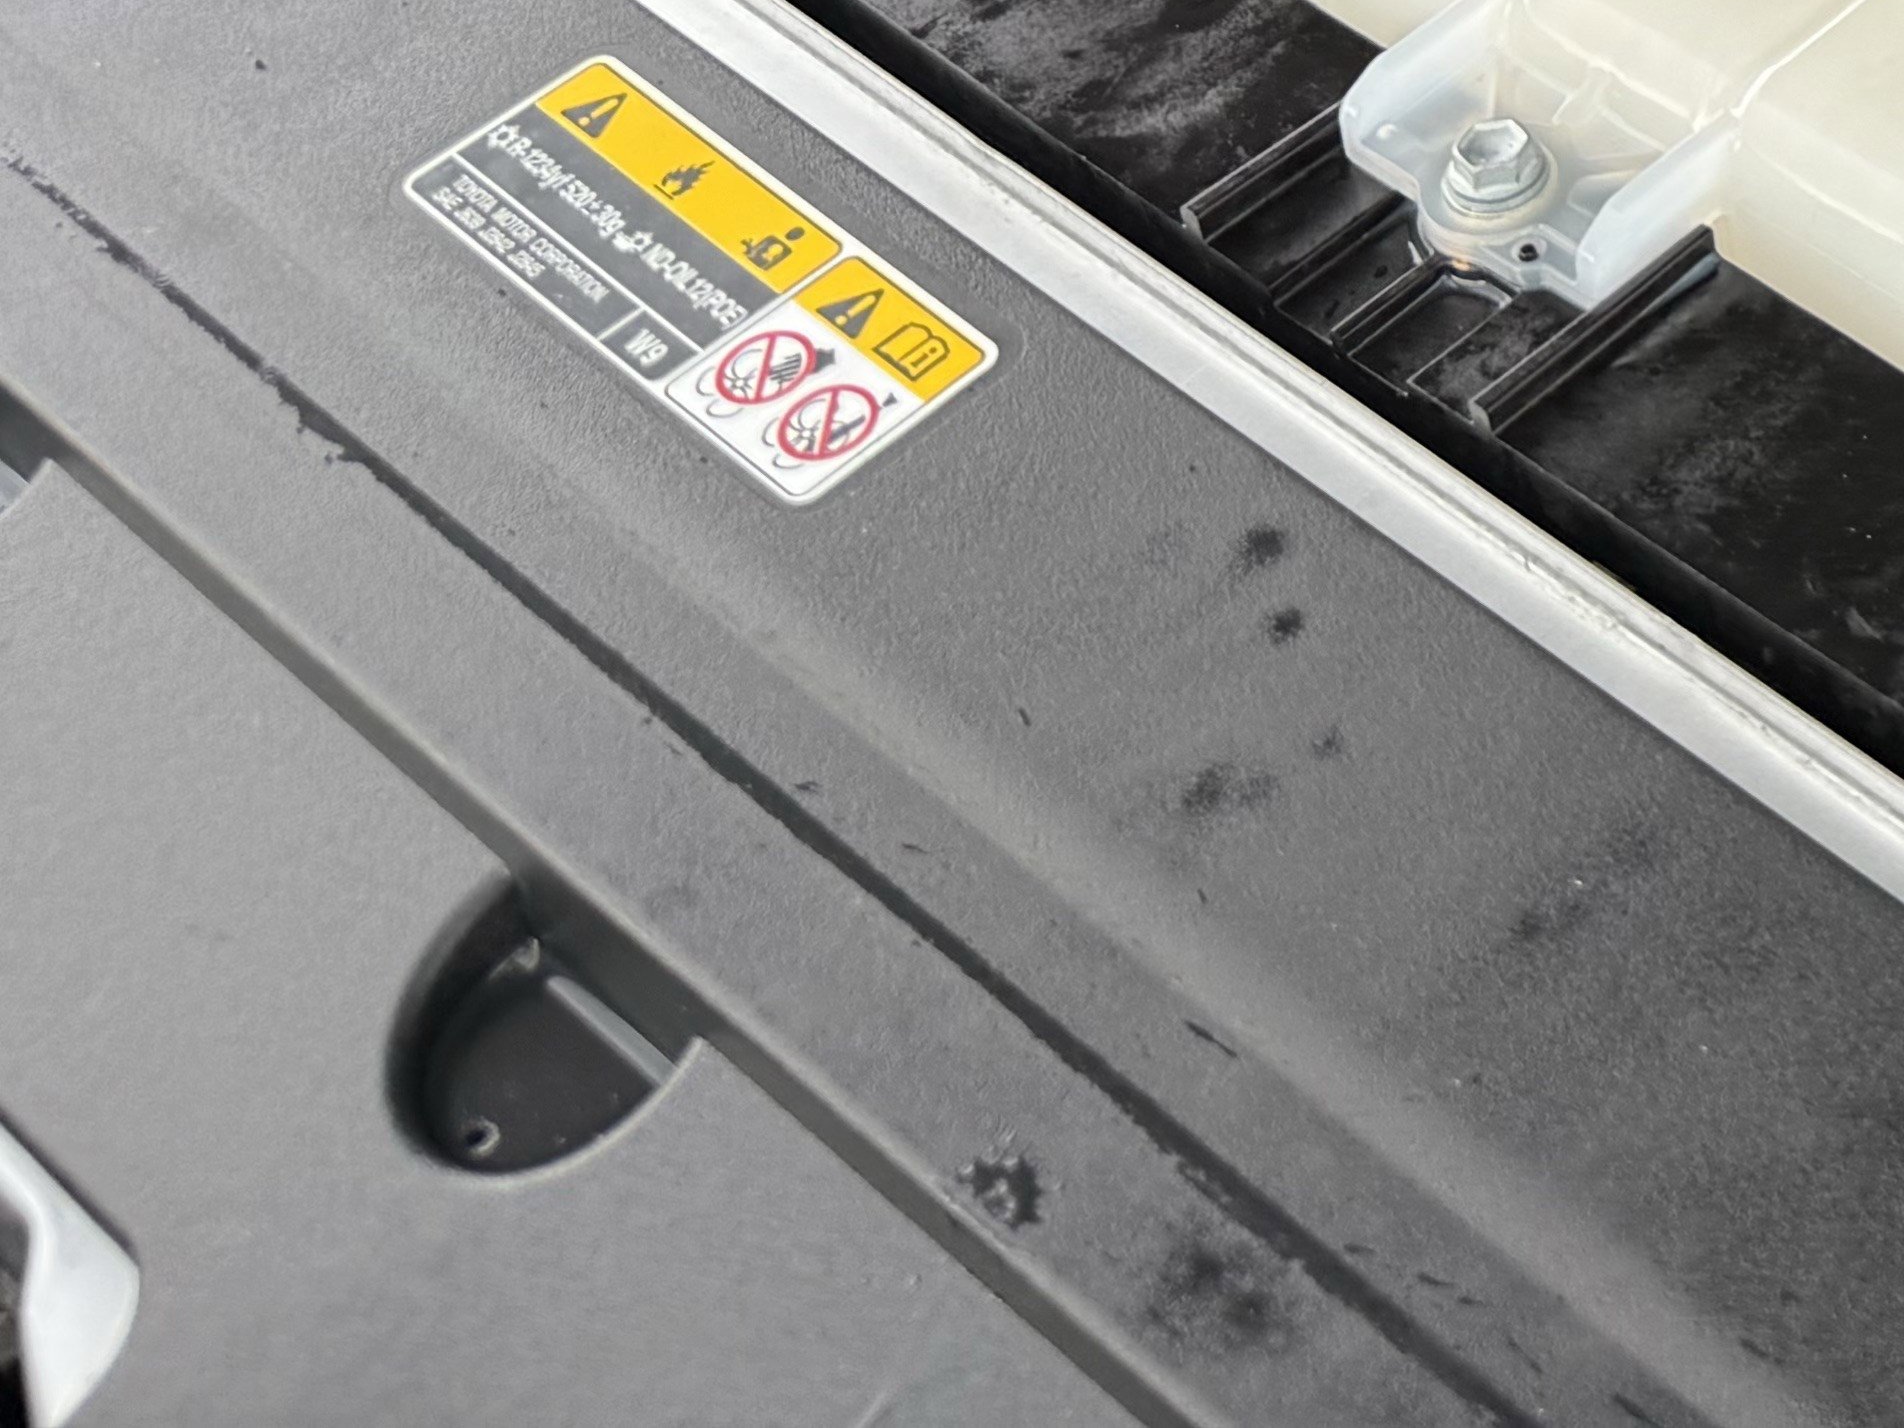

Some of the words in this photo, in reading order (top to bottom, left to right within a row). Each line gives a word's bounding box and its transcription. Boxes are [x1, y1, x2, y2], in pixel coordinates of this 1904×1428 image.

[432, 186, 463, 211] SAE
[453, 174, 498, 213] TOYOTA
[491, 207, 537, 243] MOTOR
[529, 237, 610, 304] CORPORATION
[624, 329, 669, 368] W9
